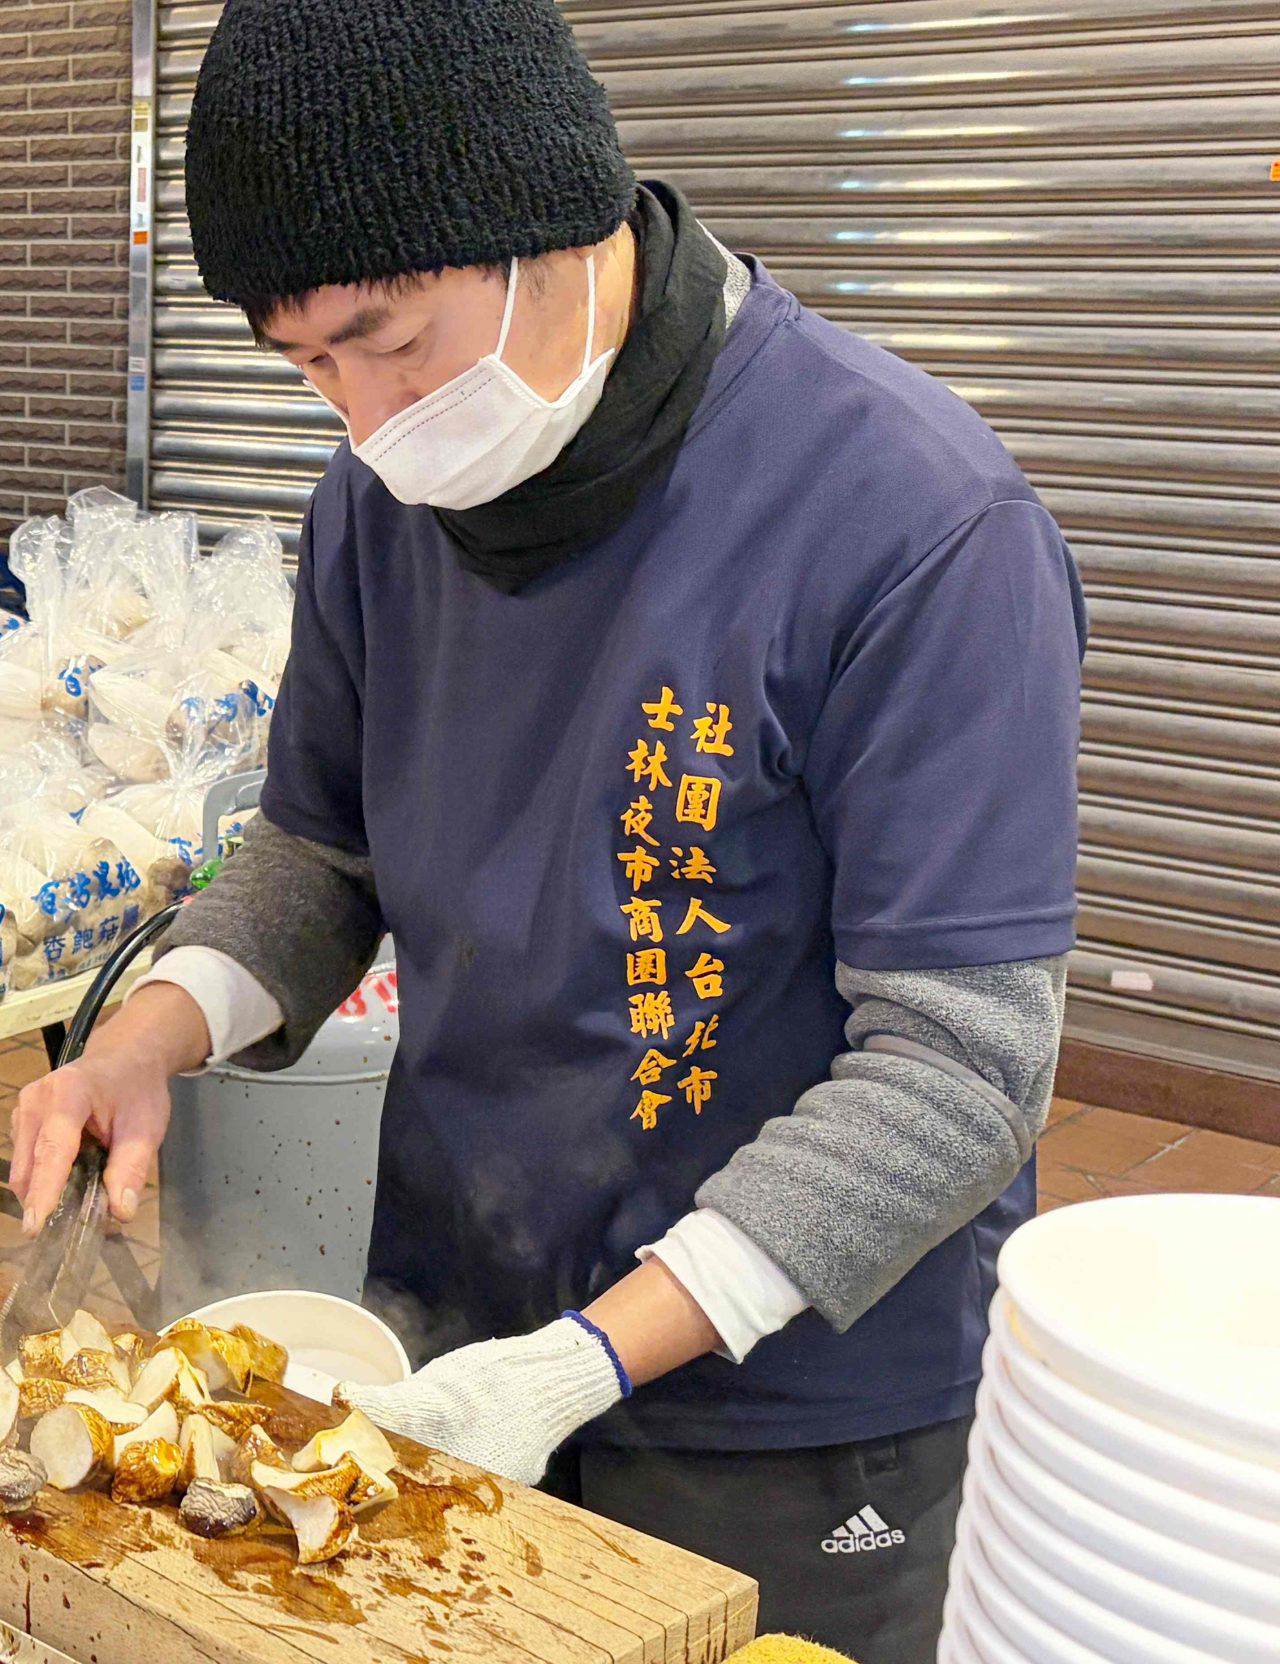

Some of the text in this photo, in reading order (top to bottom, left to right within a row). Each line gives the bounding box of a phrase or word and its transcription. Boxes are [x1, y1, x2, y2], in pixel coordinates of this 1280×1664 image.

[616, 685, 684, 1131] 士林夜市商圈聯合會
[669, 701, 735, 1115] 社團法人台北市
[821, 1529, 906, 1553] adidas
